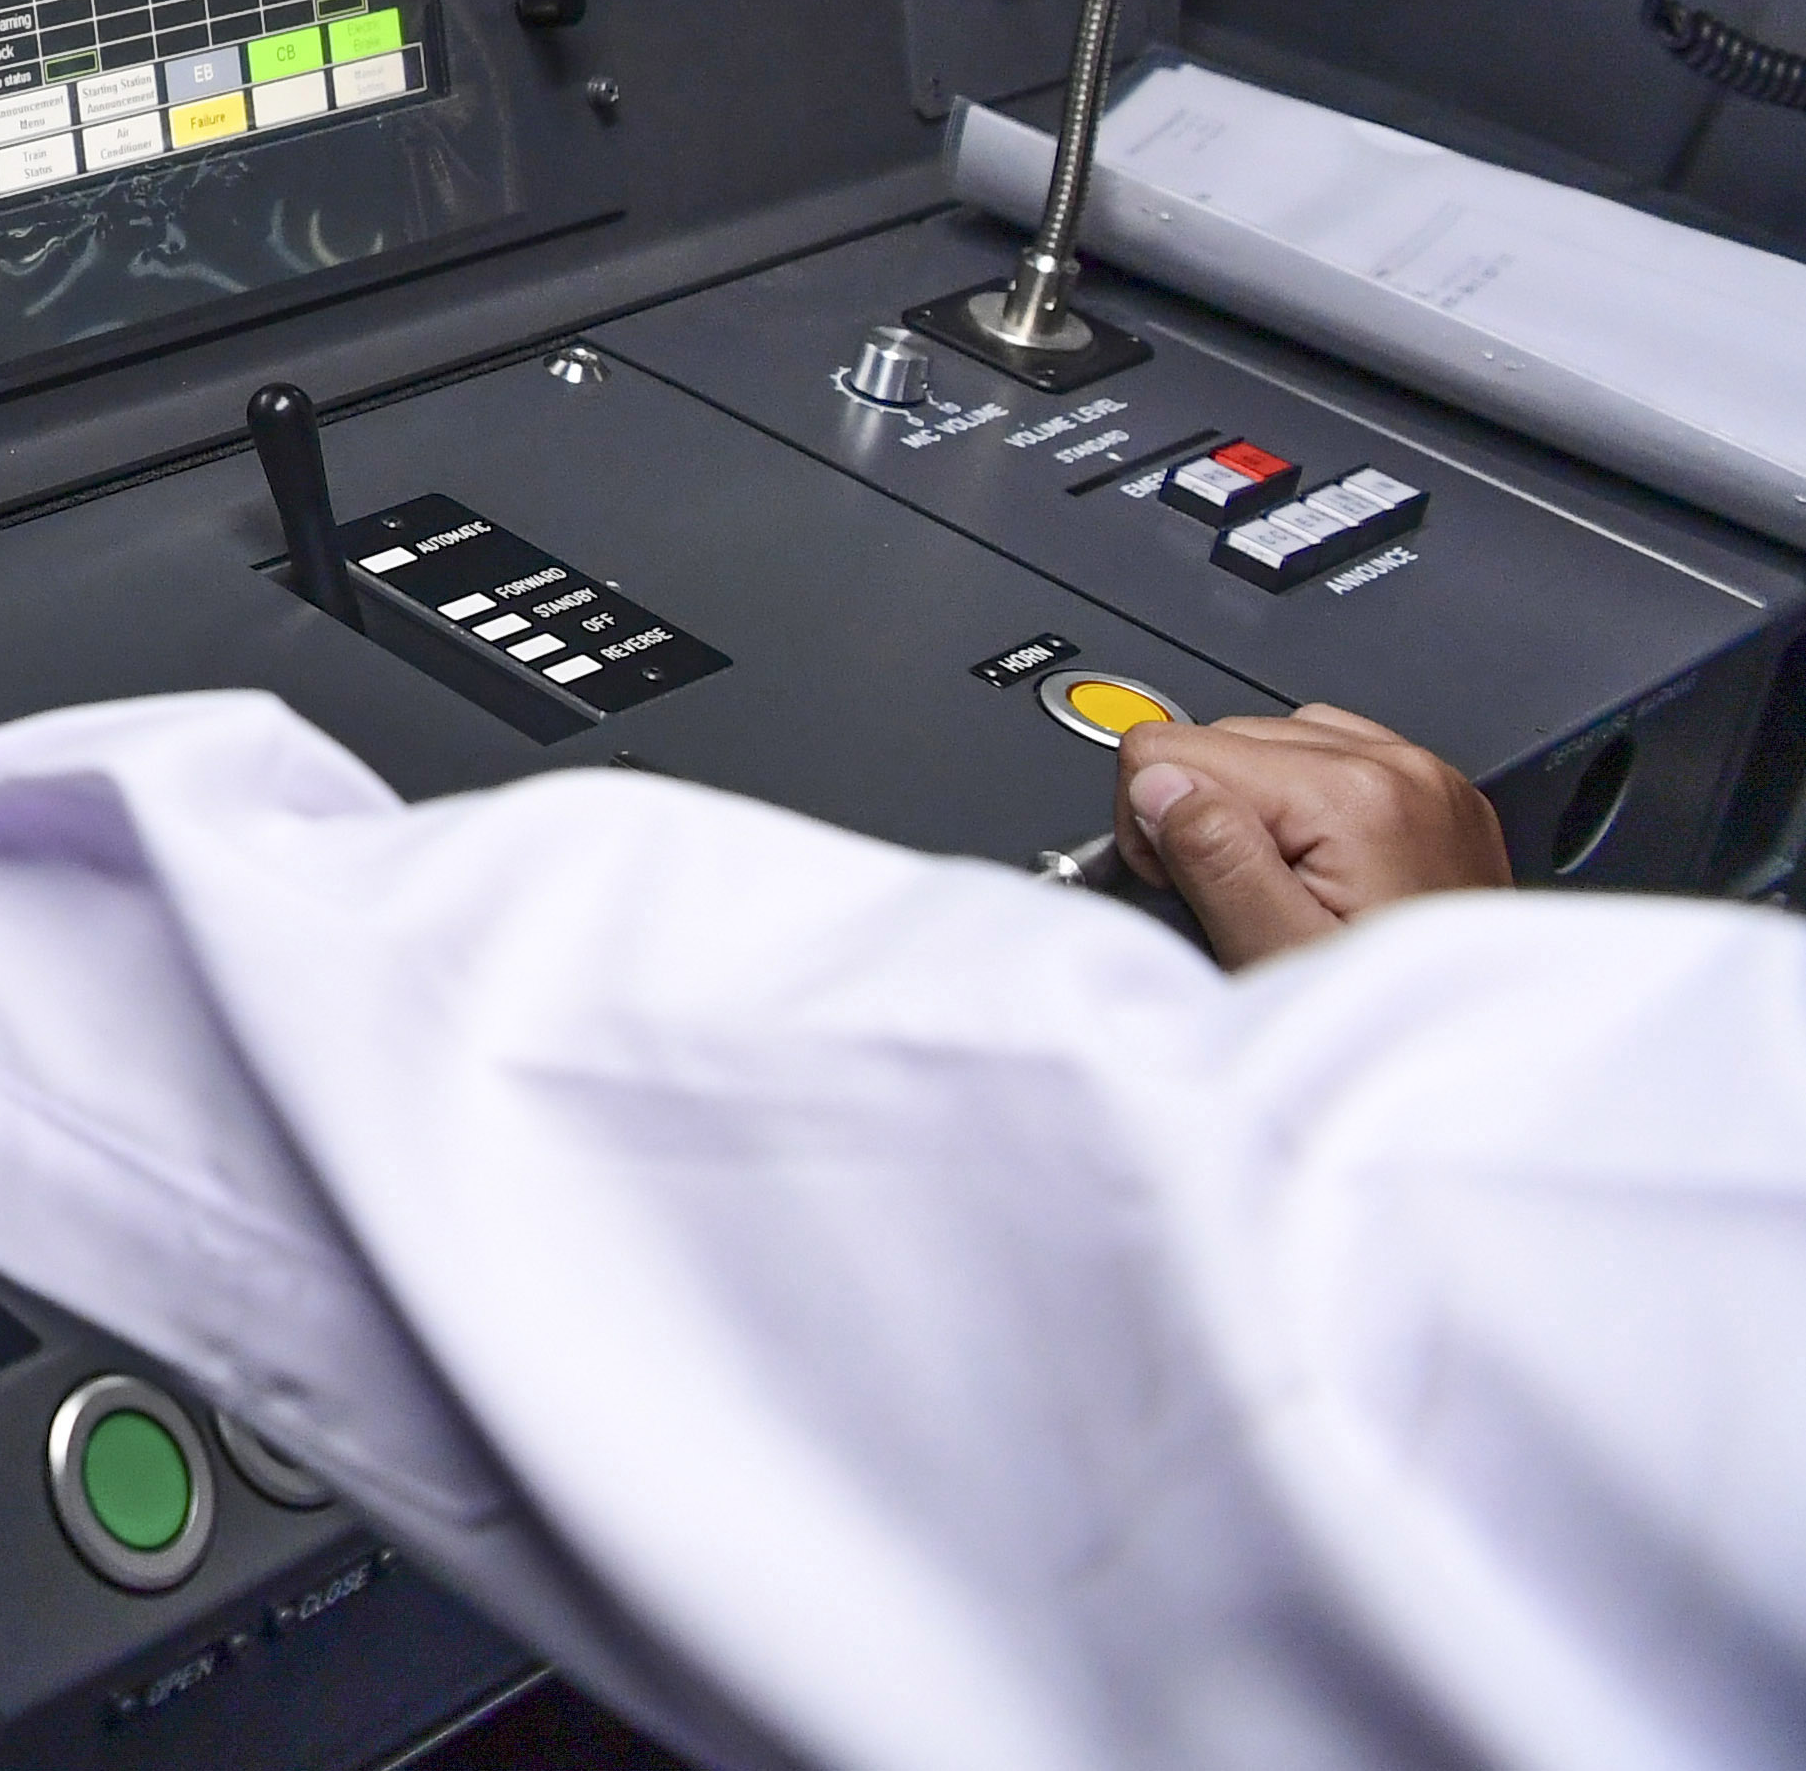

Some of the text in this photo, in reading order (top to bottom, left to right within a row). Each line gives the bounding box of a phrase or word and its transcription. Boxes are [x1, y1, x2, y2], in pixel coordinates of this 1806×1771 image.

[276, 43, 296, 62] CB
[3, 68, 31, 87] status
[82, 73, 152, 101] Starting Station
[193, 62, 214, 83] EB
[189, 109, 225, 130] Failure
[22, 148, 46, 162] Train
[100, 138, 152, 160] Conditioner
[24, 163, 52, 180] Status
[899, 402, 1010, 450] MIC VOLUME
[1002, 397, 1129, 449] VOLUME LEVEL
[1052, 429, 1131, 465] STANDARD
[415, 520, 492, 556] AUTOMATIC
[494, 566, 568, 601] FORWARD
[1323, 544, 1419, 596] ANNOUNCE
[531, 587, 599, 620] STANDBY
[581, 612, 617, 634] OFF
[600, 625, 674, 663] REVERSE
[997, 641, 1056, 675] HORN
[297, 1562, 372, 1621] CLOSE
